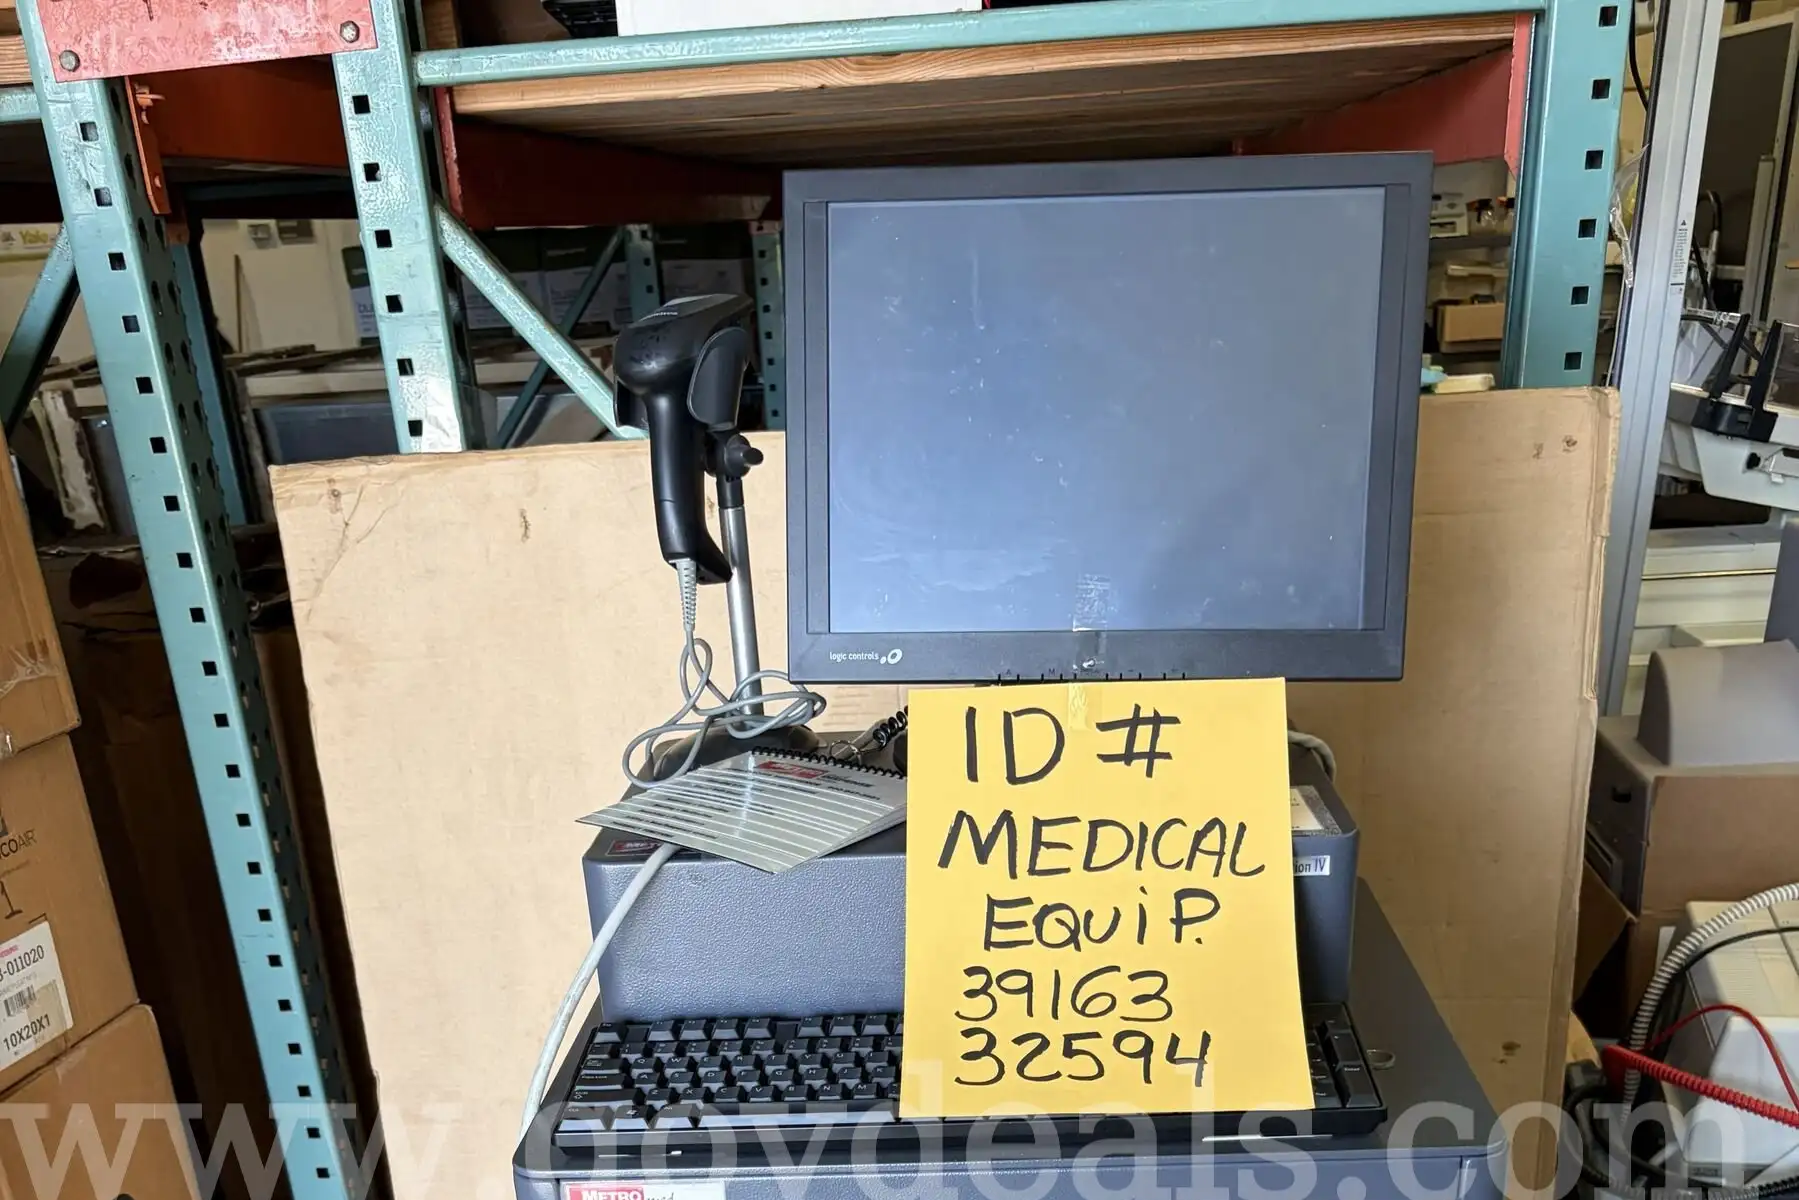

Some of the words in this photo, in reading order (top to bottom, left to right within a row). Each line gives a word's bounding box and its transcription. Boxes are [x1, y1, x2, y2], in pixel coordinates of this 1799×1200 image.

[829, 652, 847, 663] logic
[848, 652, 879, 660] controls
[964, 706, 1065, 785] ID
[1096, 703, 1181, 778] #
[0, 829, 37, 860] COAIR
[938, 809, 1266, 880] MEDICAL
[1294, 860, 1312, 873] ion
[1314, 857, 1326, 872] IV
[954, 965, 1174, 1022] 39163
[954, 1027, 1212, 1087] 32594
